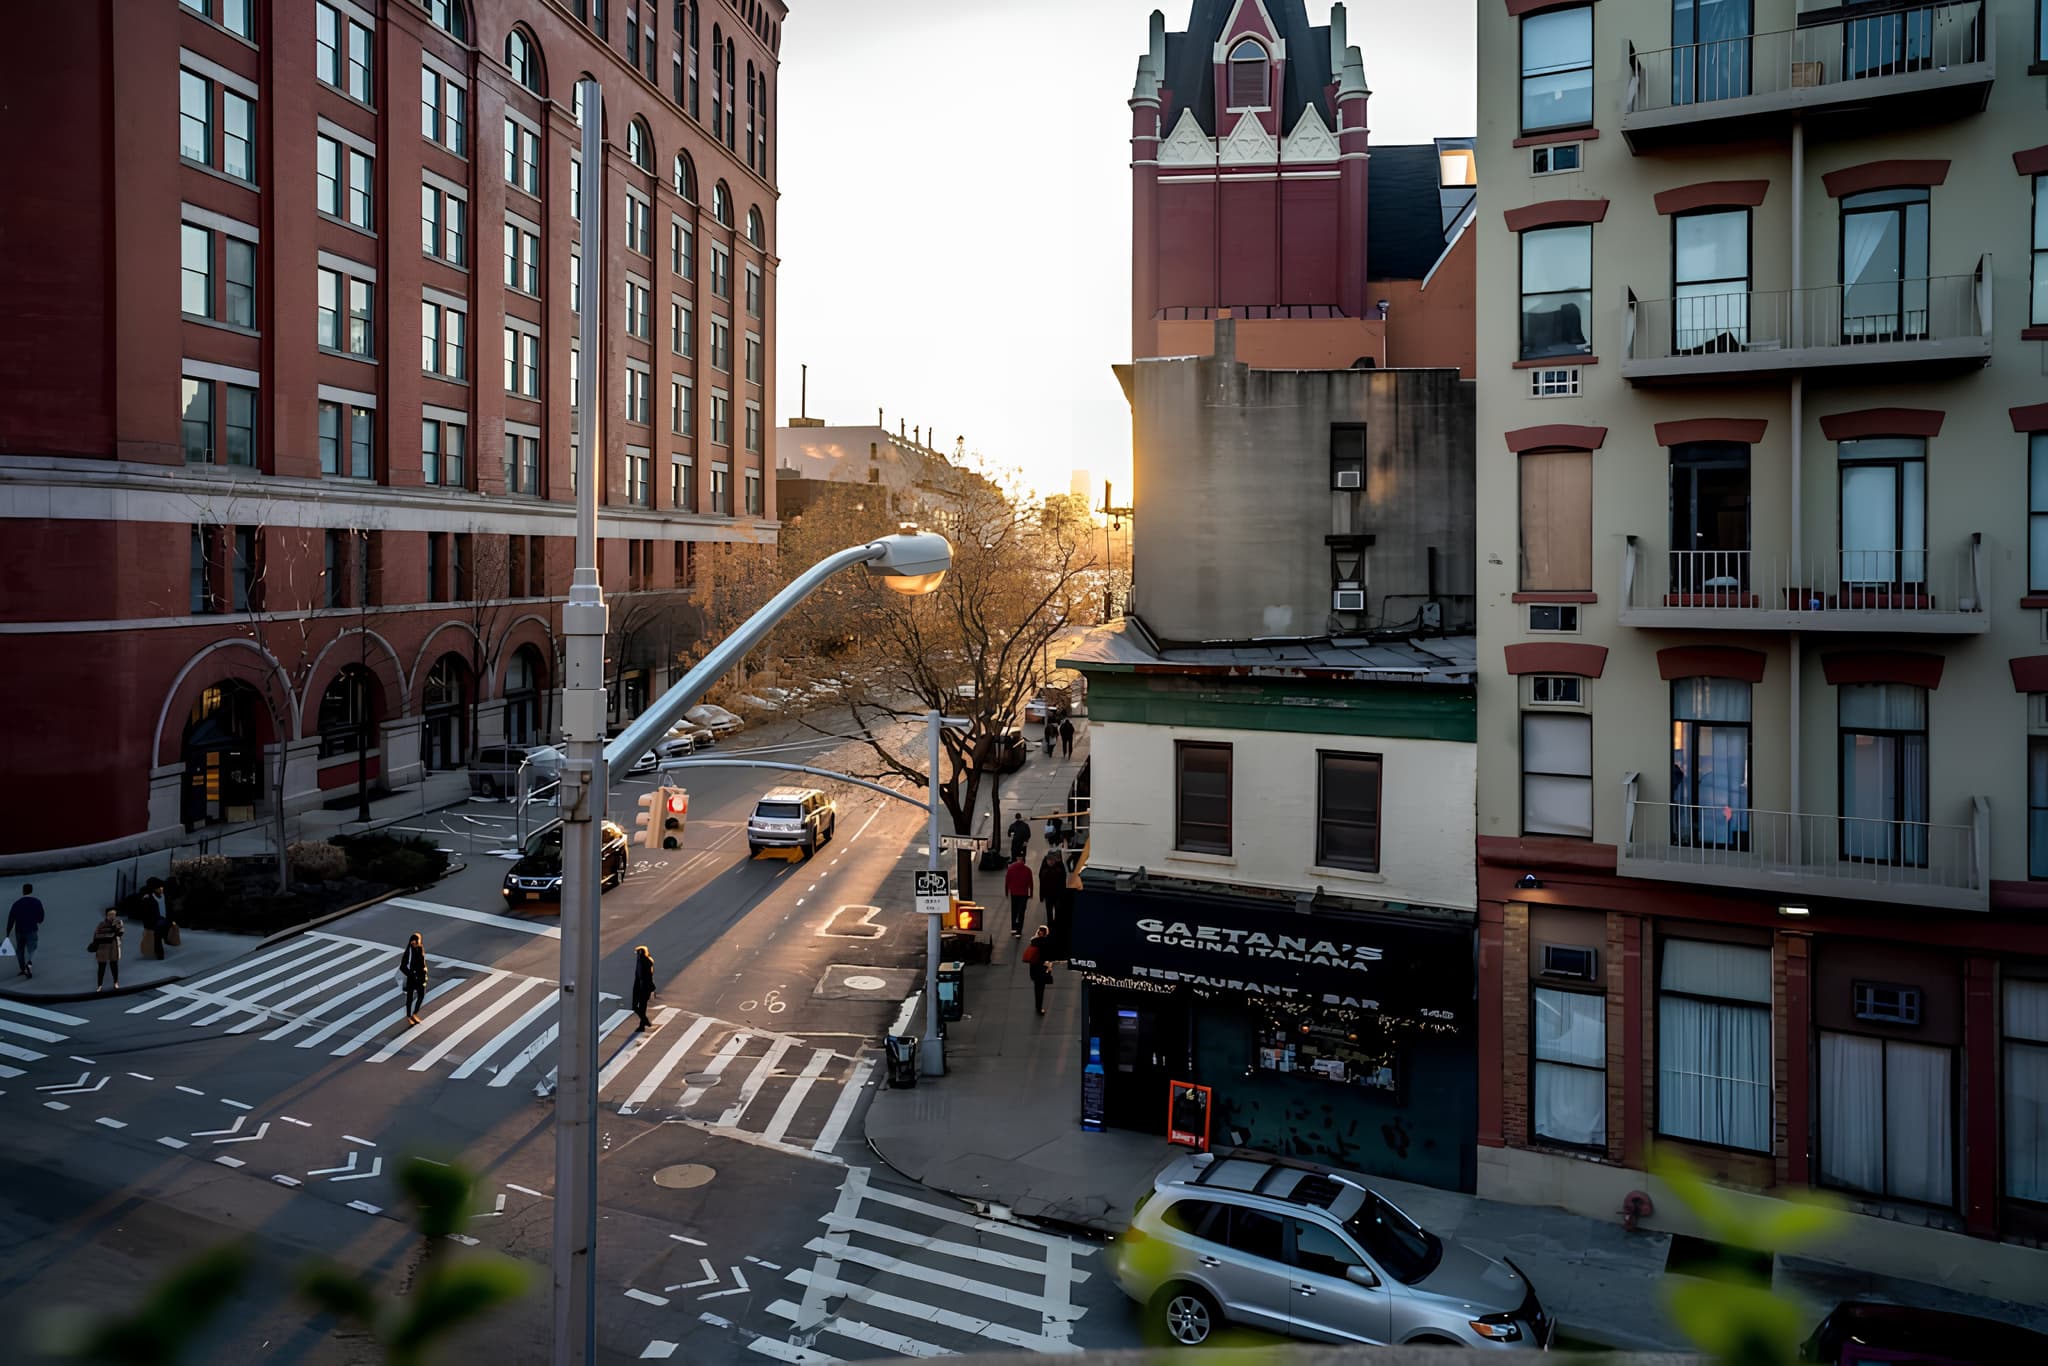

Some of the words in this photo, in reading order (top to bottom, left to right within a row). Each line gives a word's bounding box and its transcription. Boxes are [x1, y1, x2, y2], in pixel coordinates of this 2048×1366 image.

[1136, 918, 1384, 961] GAETANA'S
[1146, 934, 1240, 955] CUCINA
[1248, 947, 1368, 972] ITALIANA
[1132, 966, 1299, 998] RESTAURANT
[1322, 993, 1380, 1010] BAR
